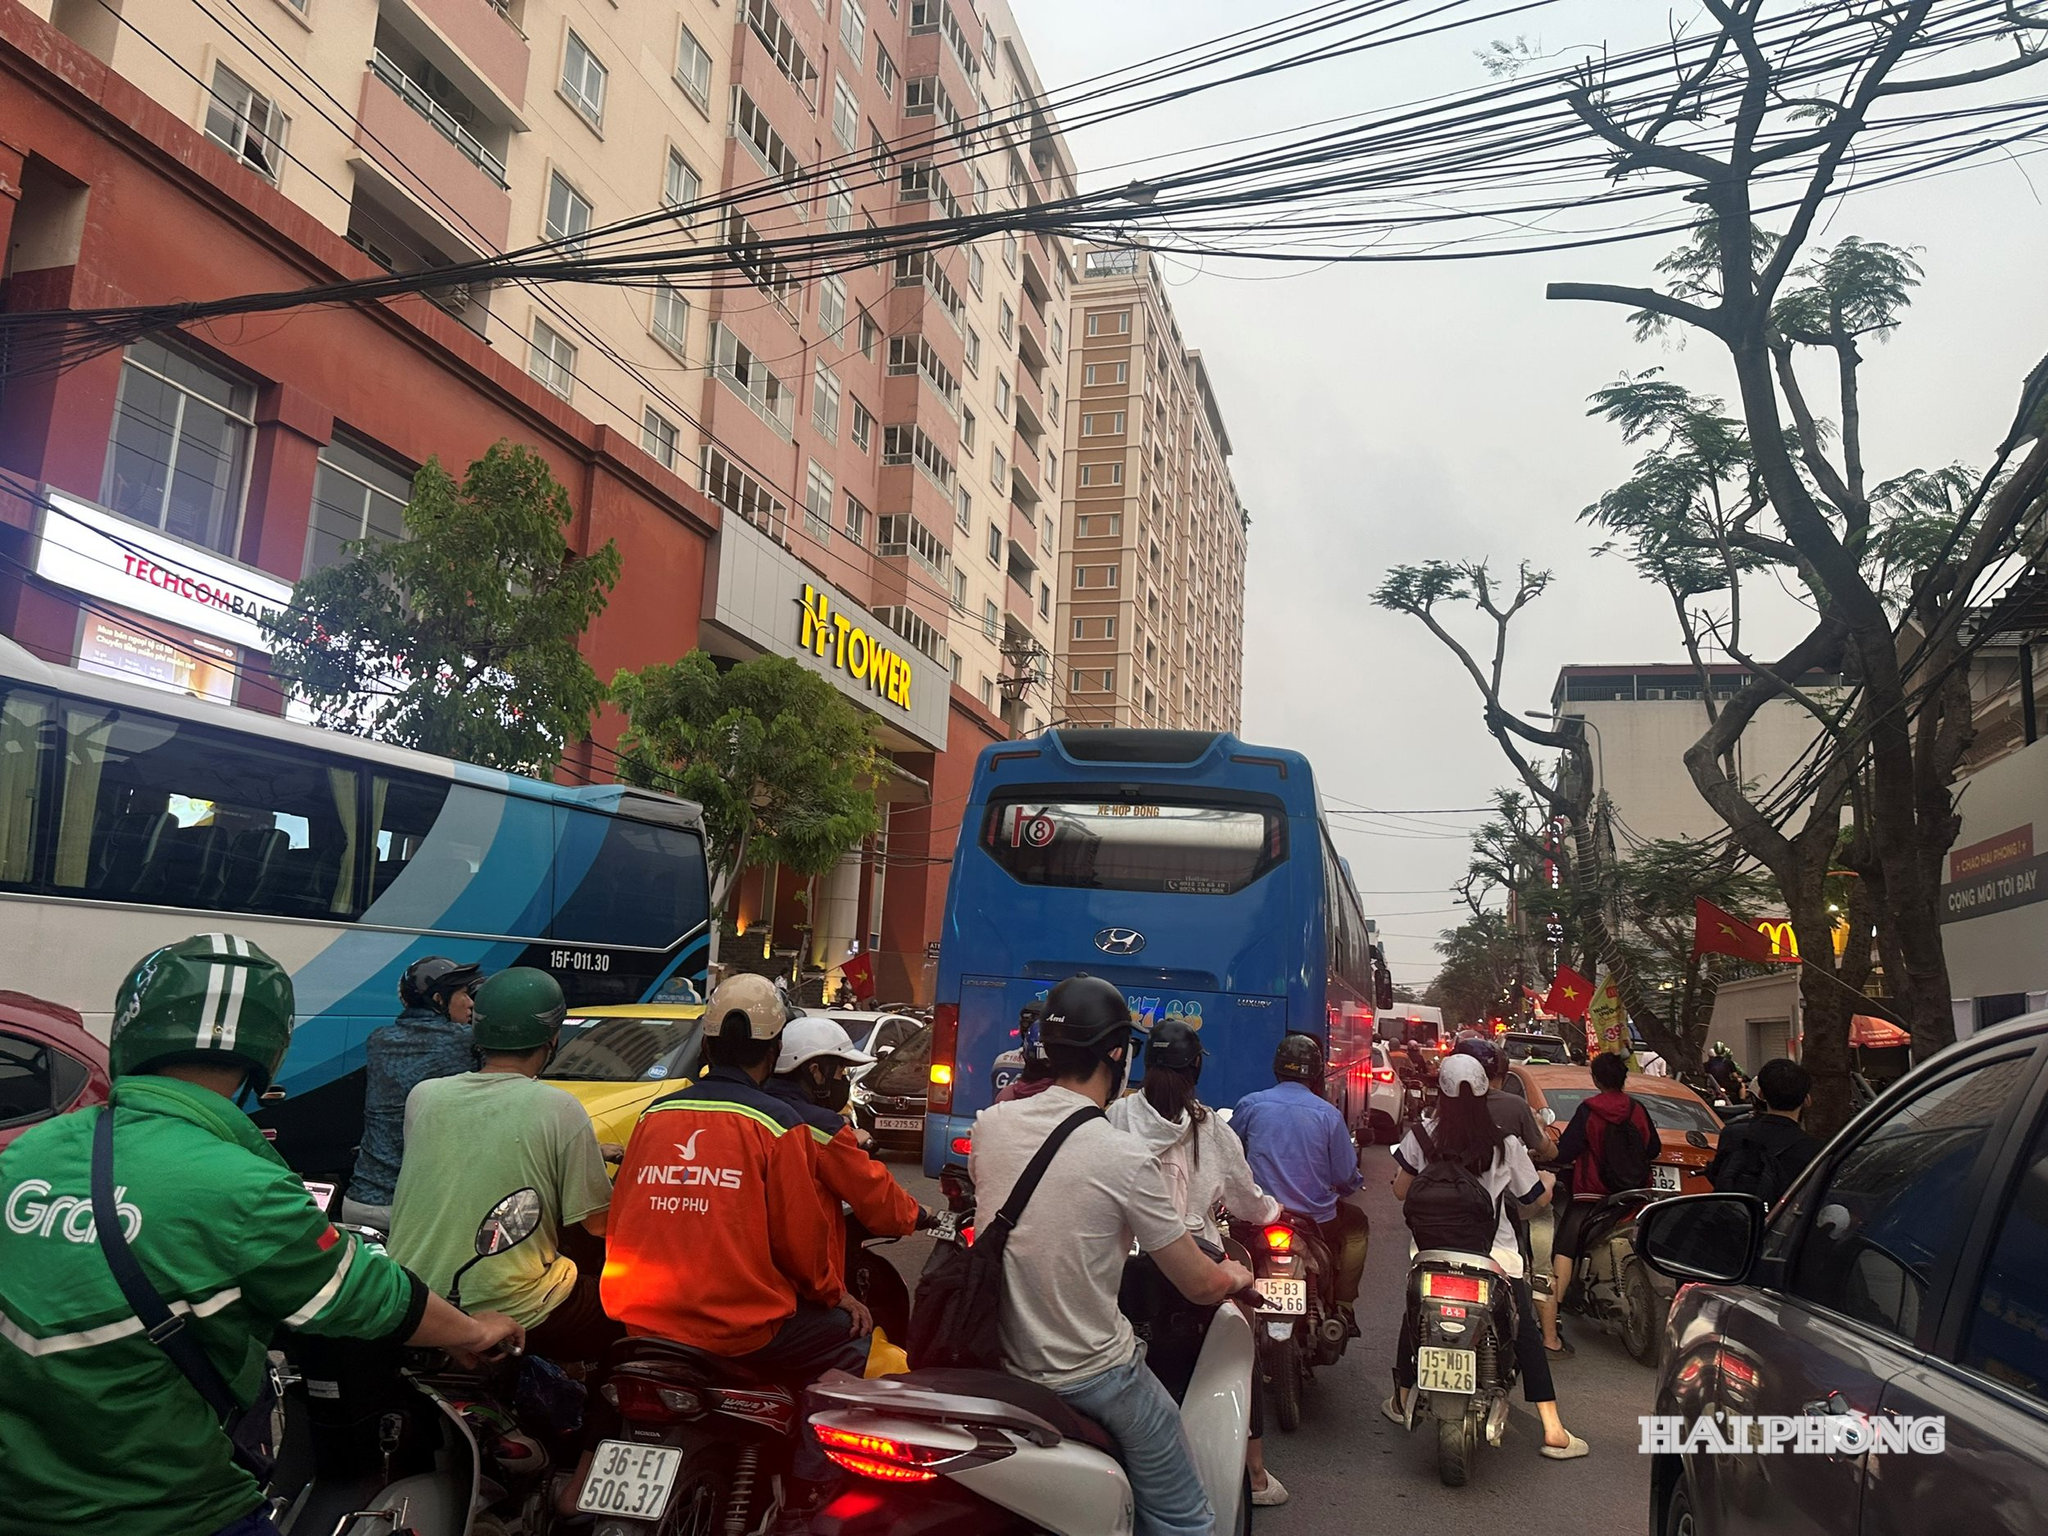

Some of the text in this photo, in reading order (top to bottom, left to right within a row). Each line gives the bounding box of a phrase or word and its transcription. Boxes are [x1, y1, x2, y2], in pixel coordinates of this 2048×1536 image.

[1097, 804, 1110, 816] XE
[637, 1165, 743, 1189] VINCONS
[5, 1179, 142, 1244] Grab
[650, 1196, 709, 1215] THỢ PHỤ
[1421, 1369, 1473, 1391] 714.26
[603, 1446, 667, 1481] 36-E1
[584, 1477, 665, 1514] 506.37
